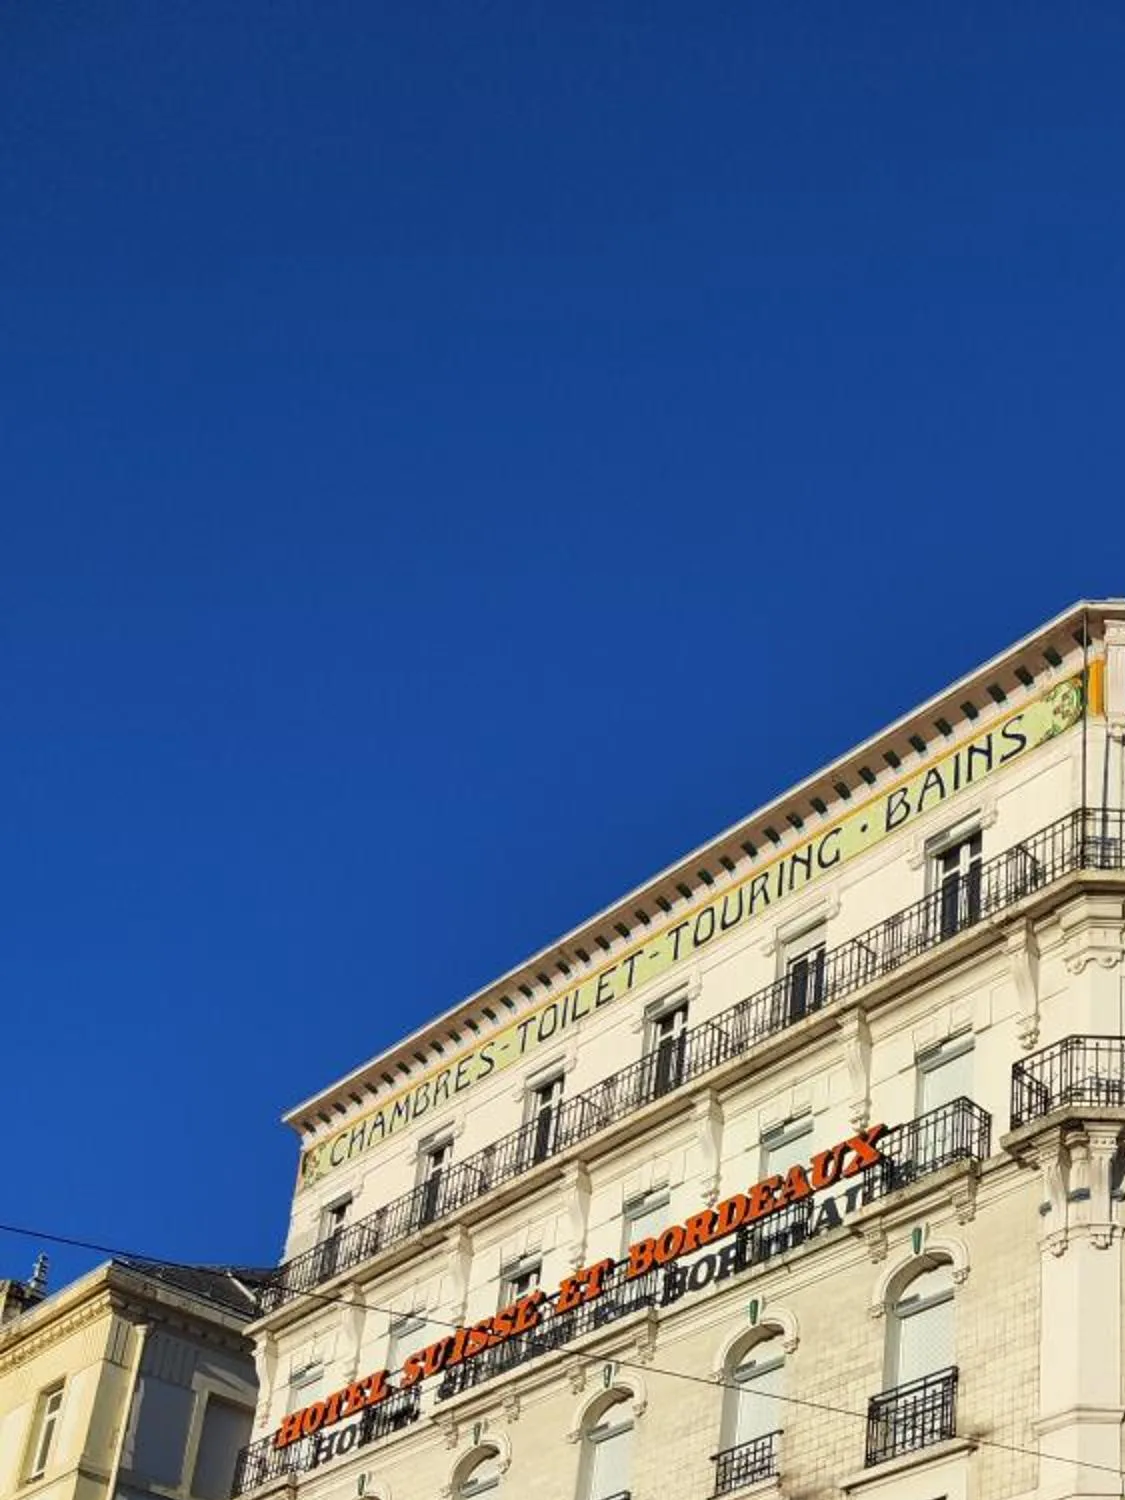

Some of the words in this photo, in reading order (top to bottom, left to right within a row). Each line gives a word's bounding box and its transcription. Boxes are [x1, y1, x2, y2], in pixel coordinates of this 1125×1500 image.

[884, 714, 1028, 832] BAINS
[272, 1369, 391, 1449] HOTEL
[401, 1289, 546, 1388] SUISSE
[554, 1258, 614, 1314] ET
[624, 1123, 889, 1279] BORDEAUX
